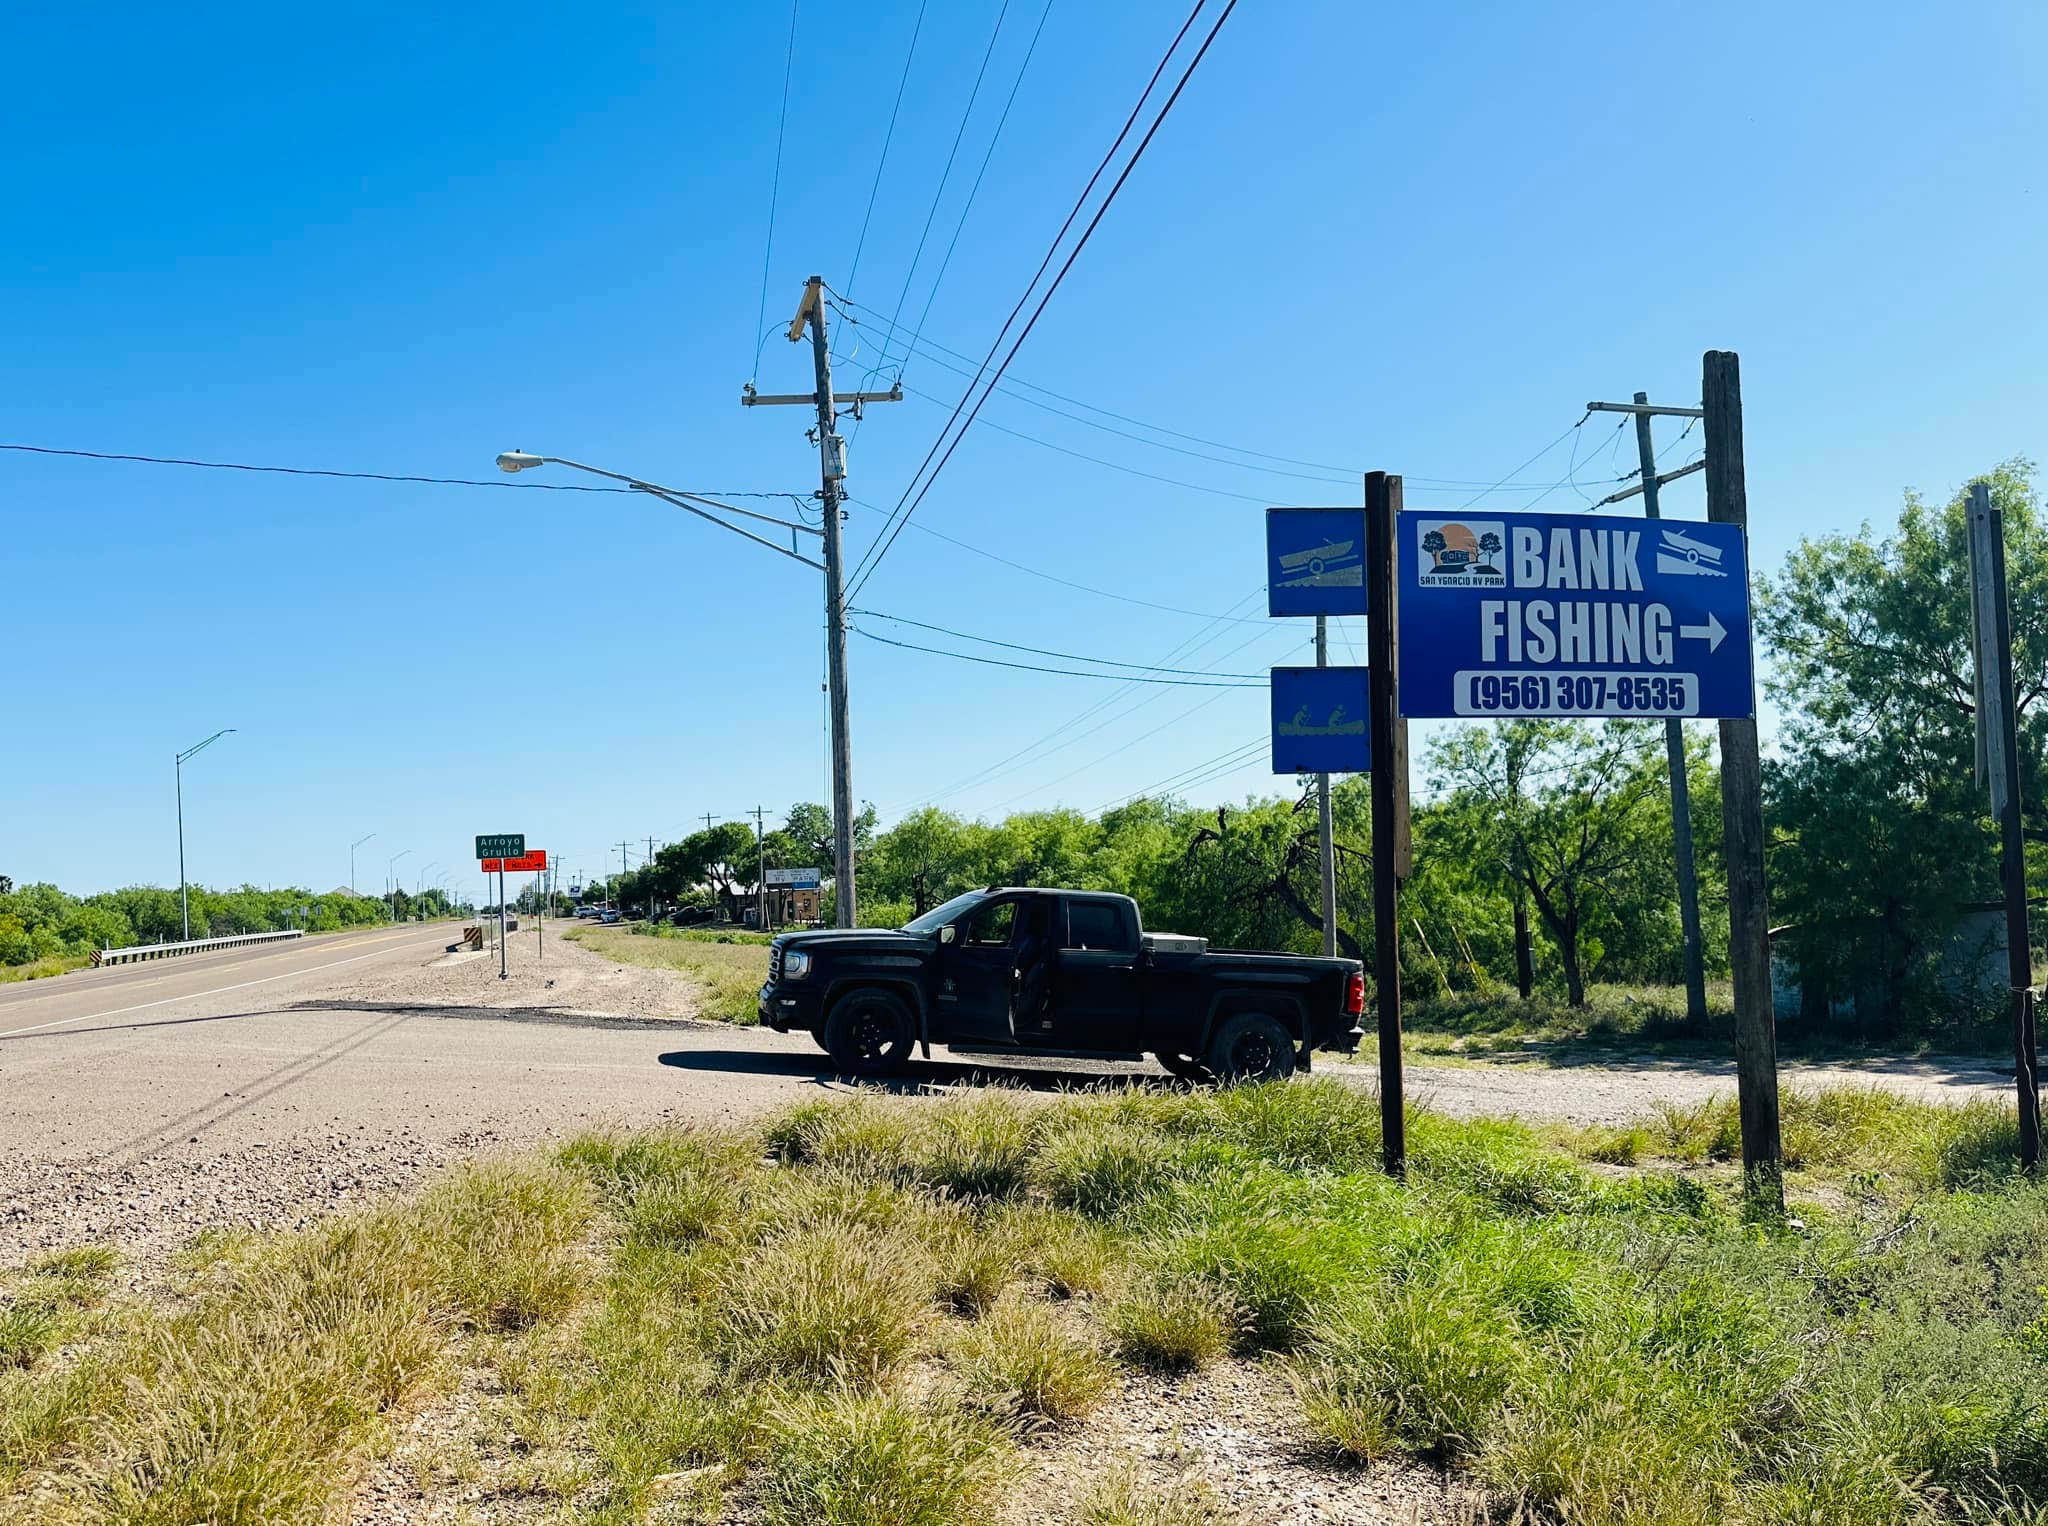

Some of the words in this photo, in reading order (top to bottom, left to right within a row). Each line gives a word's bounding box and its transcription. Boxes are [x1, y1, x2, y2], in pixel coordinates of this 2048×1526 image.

[1512, 526, 1644, 592] BANK
[1420, 576, 1436, 585] SAN
[1438, 576, 1471, 586] YGNACIO
[1473, 577, 1484, 586] RV
[1485, 577, 1505, 586] PARK
[1481, 600, 1674, 665] FISHING
[1470, 675, 1550, 710] (956)
[1557, 677, 1686, 711] 307-8535
[480, 838, 520, 847] Arroyo
[482, 848, 519, 857] Grullo
